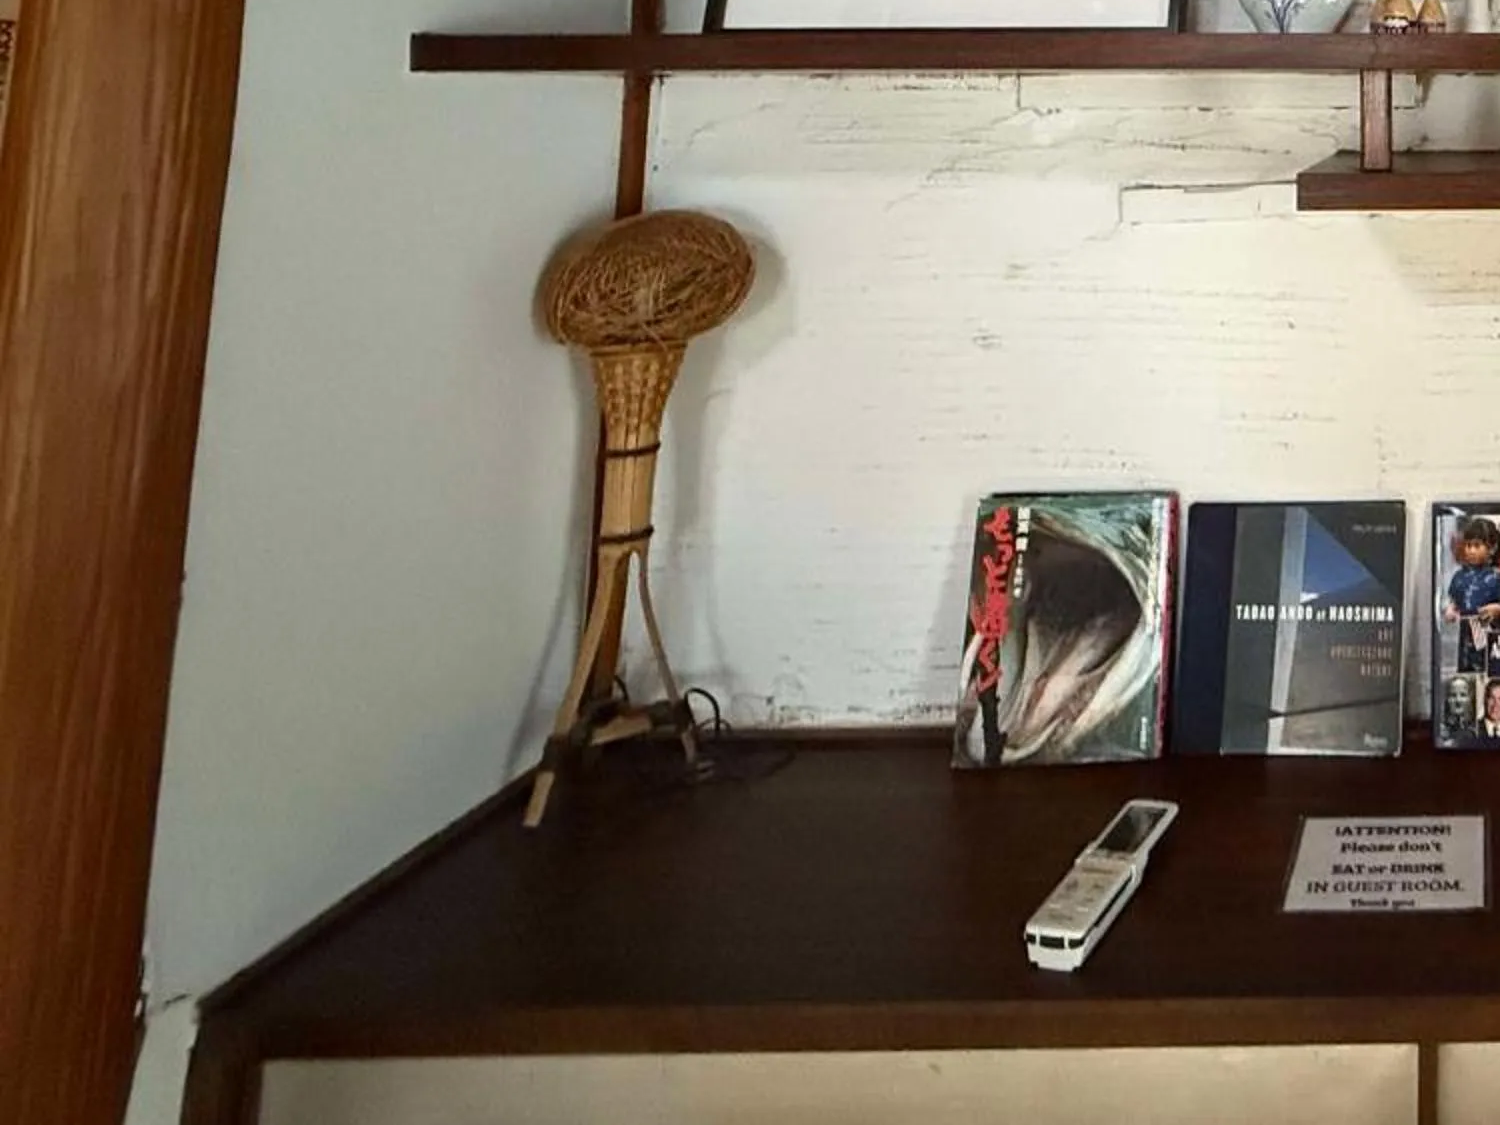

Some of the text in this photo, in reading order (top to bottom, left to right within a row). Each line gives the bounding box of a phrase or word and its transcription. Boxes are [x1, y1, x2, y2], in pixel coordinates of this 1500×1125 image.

[1236, 605, 1275, 621] TADAO
[1279, 605, 1313, 621] ANDO
[1329, 605, 1394, 622] NAOSHIMA
[1341, 840, 1442, 854] Please don't
[1332, 863, 1445, 876] EAT or DRINK
[1307, 879, 1465, 893] IN GUEST ROOM.
